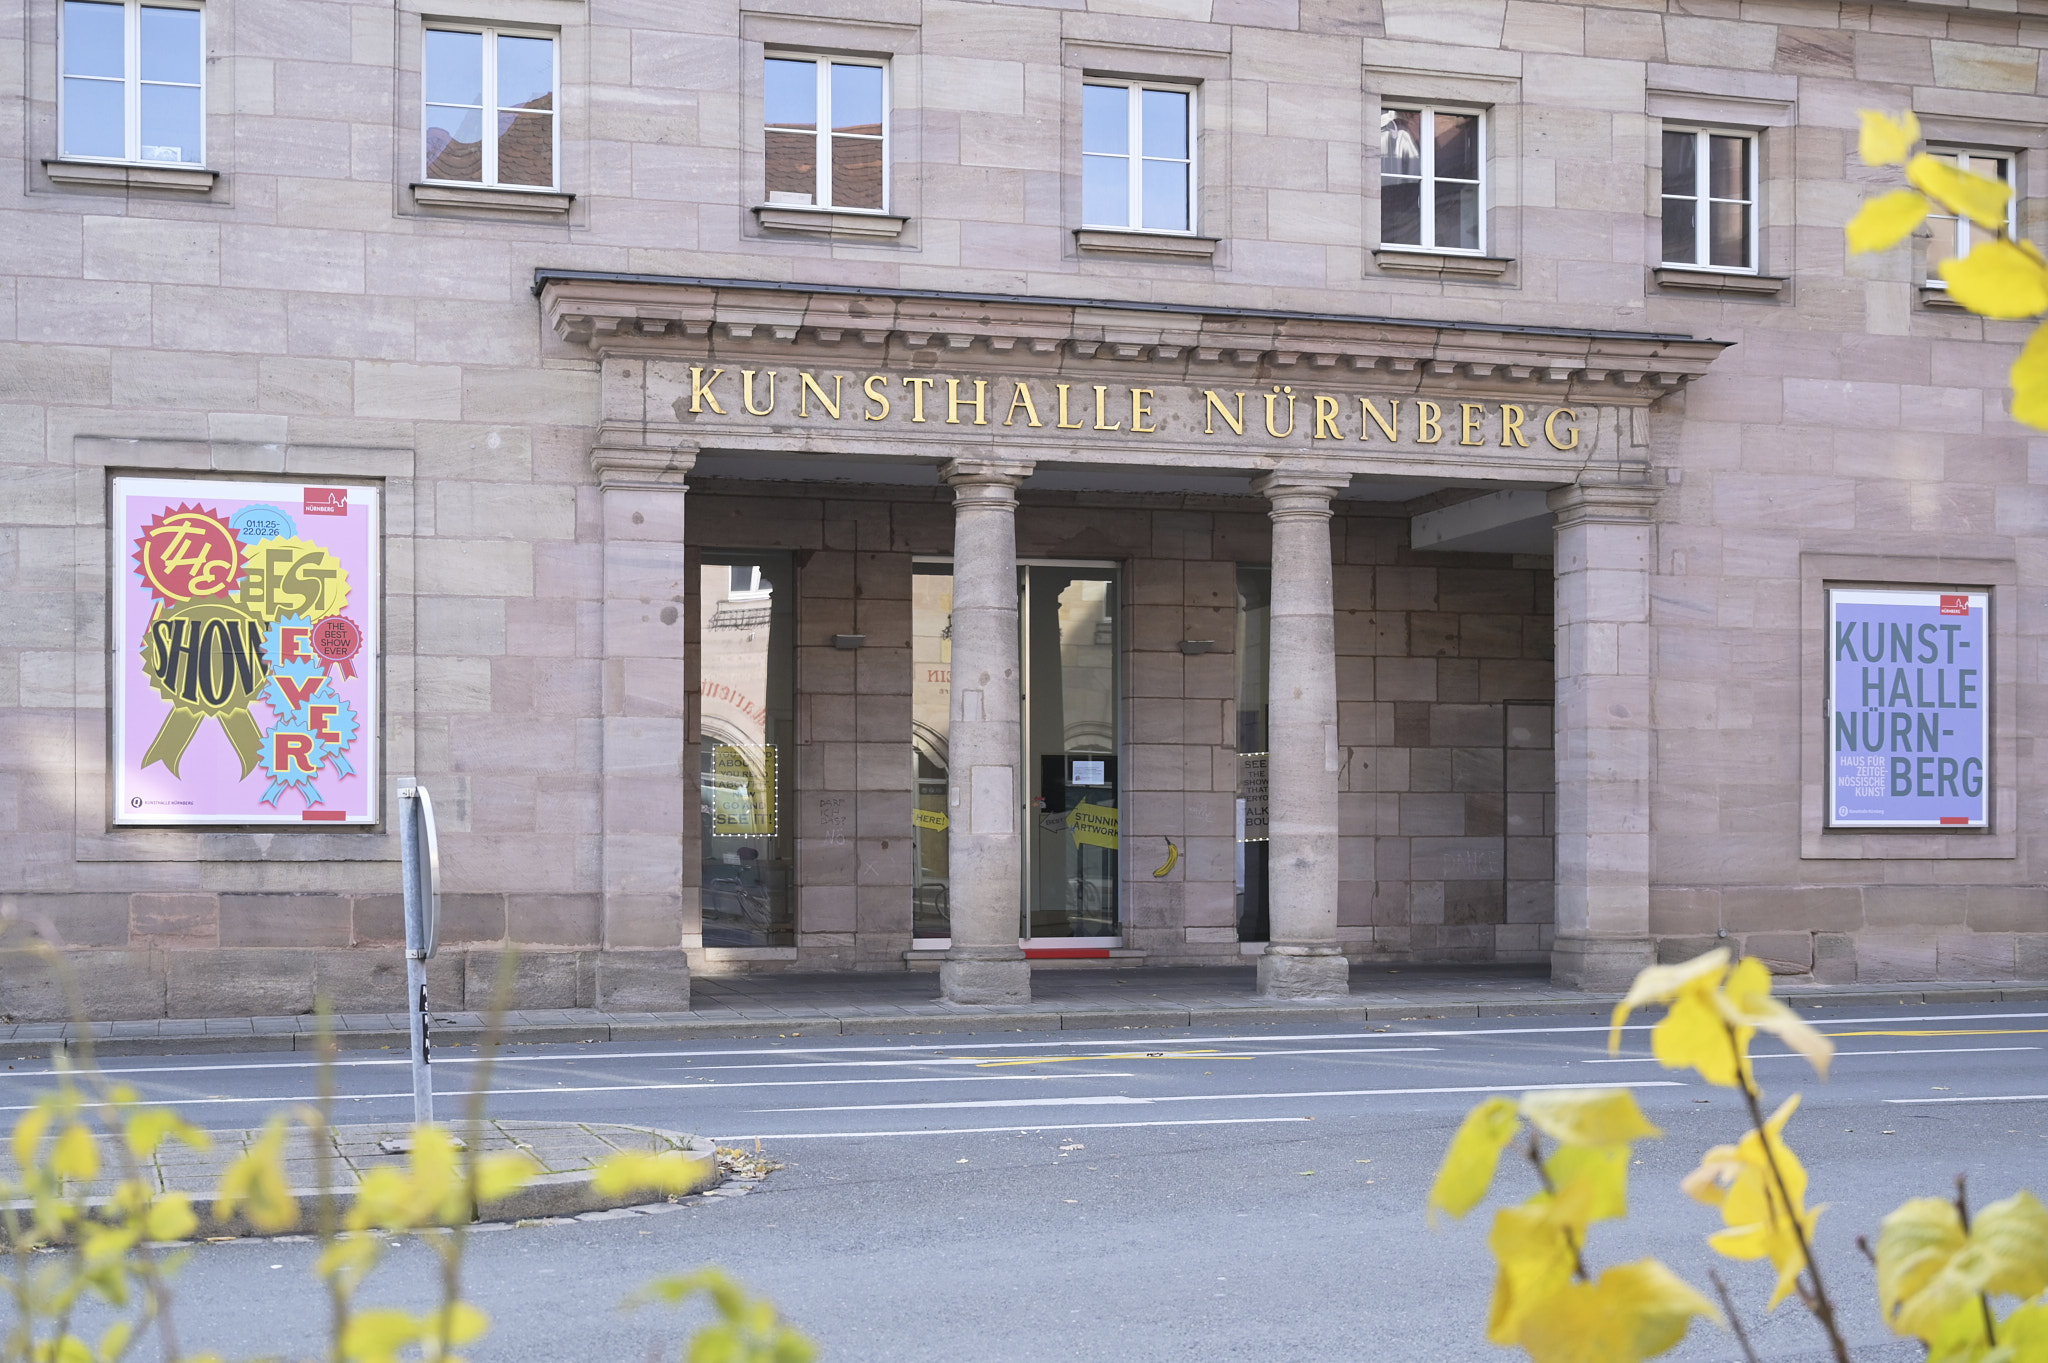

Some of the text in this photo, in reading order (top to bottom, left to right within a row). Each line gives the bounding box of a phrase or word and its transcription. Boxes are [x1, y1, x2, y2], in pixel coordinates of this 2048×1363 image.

[689, 367, 1581, 451] KUNSTHALLE NÜRNBERG
[305, 505, 335, 513] NÜRNBERG
[246, 519, 280, 529] 01.11.25-
[243, 527, 280, 537] 22.02.26
[150, 520, 232, 596] THE
[240, 549, 337, 624] BEST
[327, 622, 345, 631] THE
[324, 630, 348, 639] BEST
[321, 638, 351, 647] SHOW
[1836, 621, 1971, 664] KUNST-
[324, 646, 348, 655] EVER
[152, 618, 271, 706] SHOW
[1862, 667, 1977, 709] HALLE
[1836, 707, 1954, 752] NÜRN-
[1244, 760, 1267, 769] SEE
[1840, 755, 1885, 766] HAUS FÜR
[1856, 766, 1888, 777] ZEITGE-
[1891, 757, 1983, 797] BERG
[1838, 775, 1885, 787] NÖSSISCHE
[1855, 786, 1886, 797] KUNST
[722, 801, 740, 809] GO
[716, 813, 772, 825] SEE IT!
[916, 814, 945, 825] HERE!
